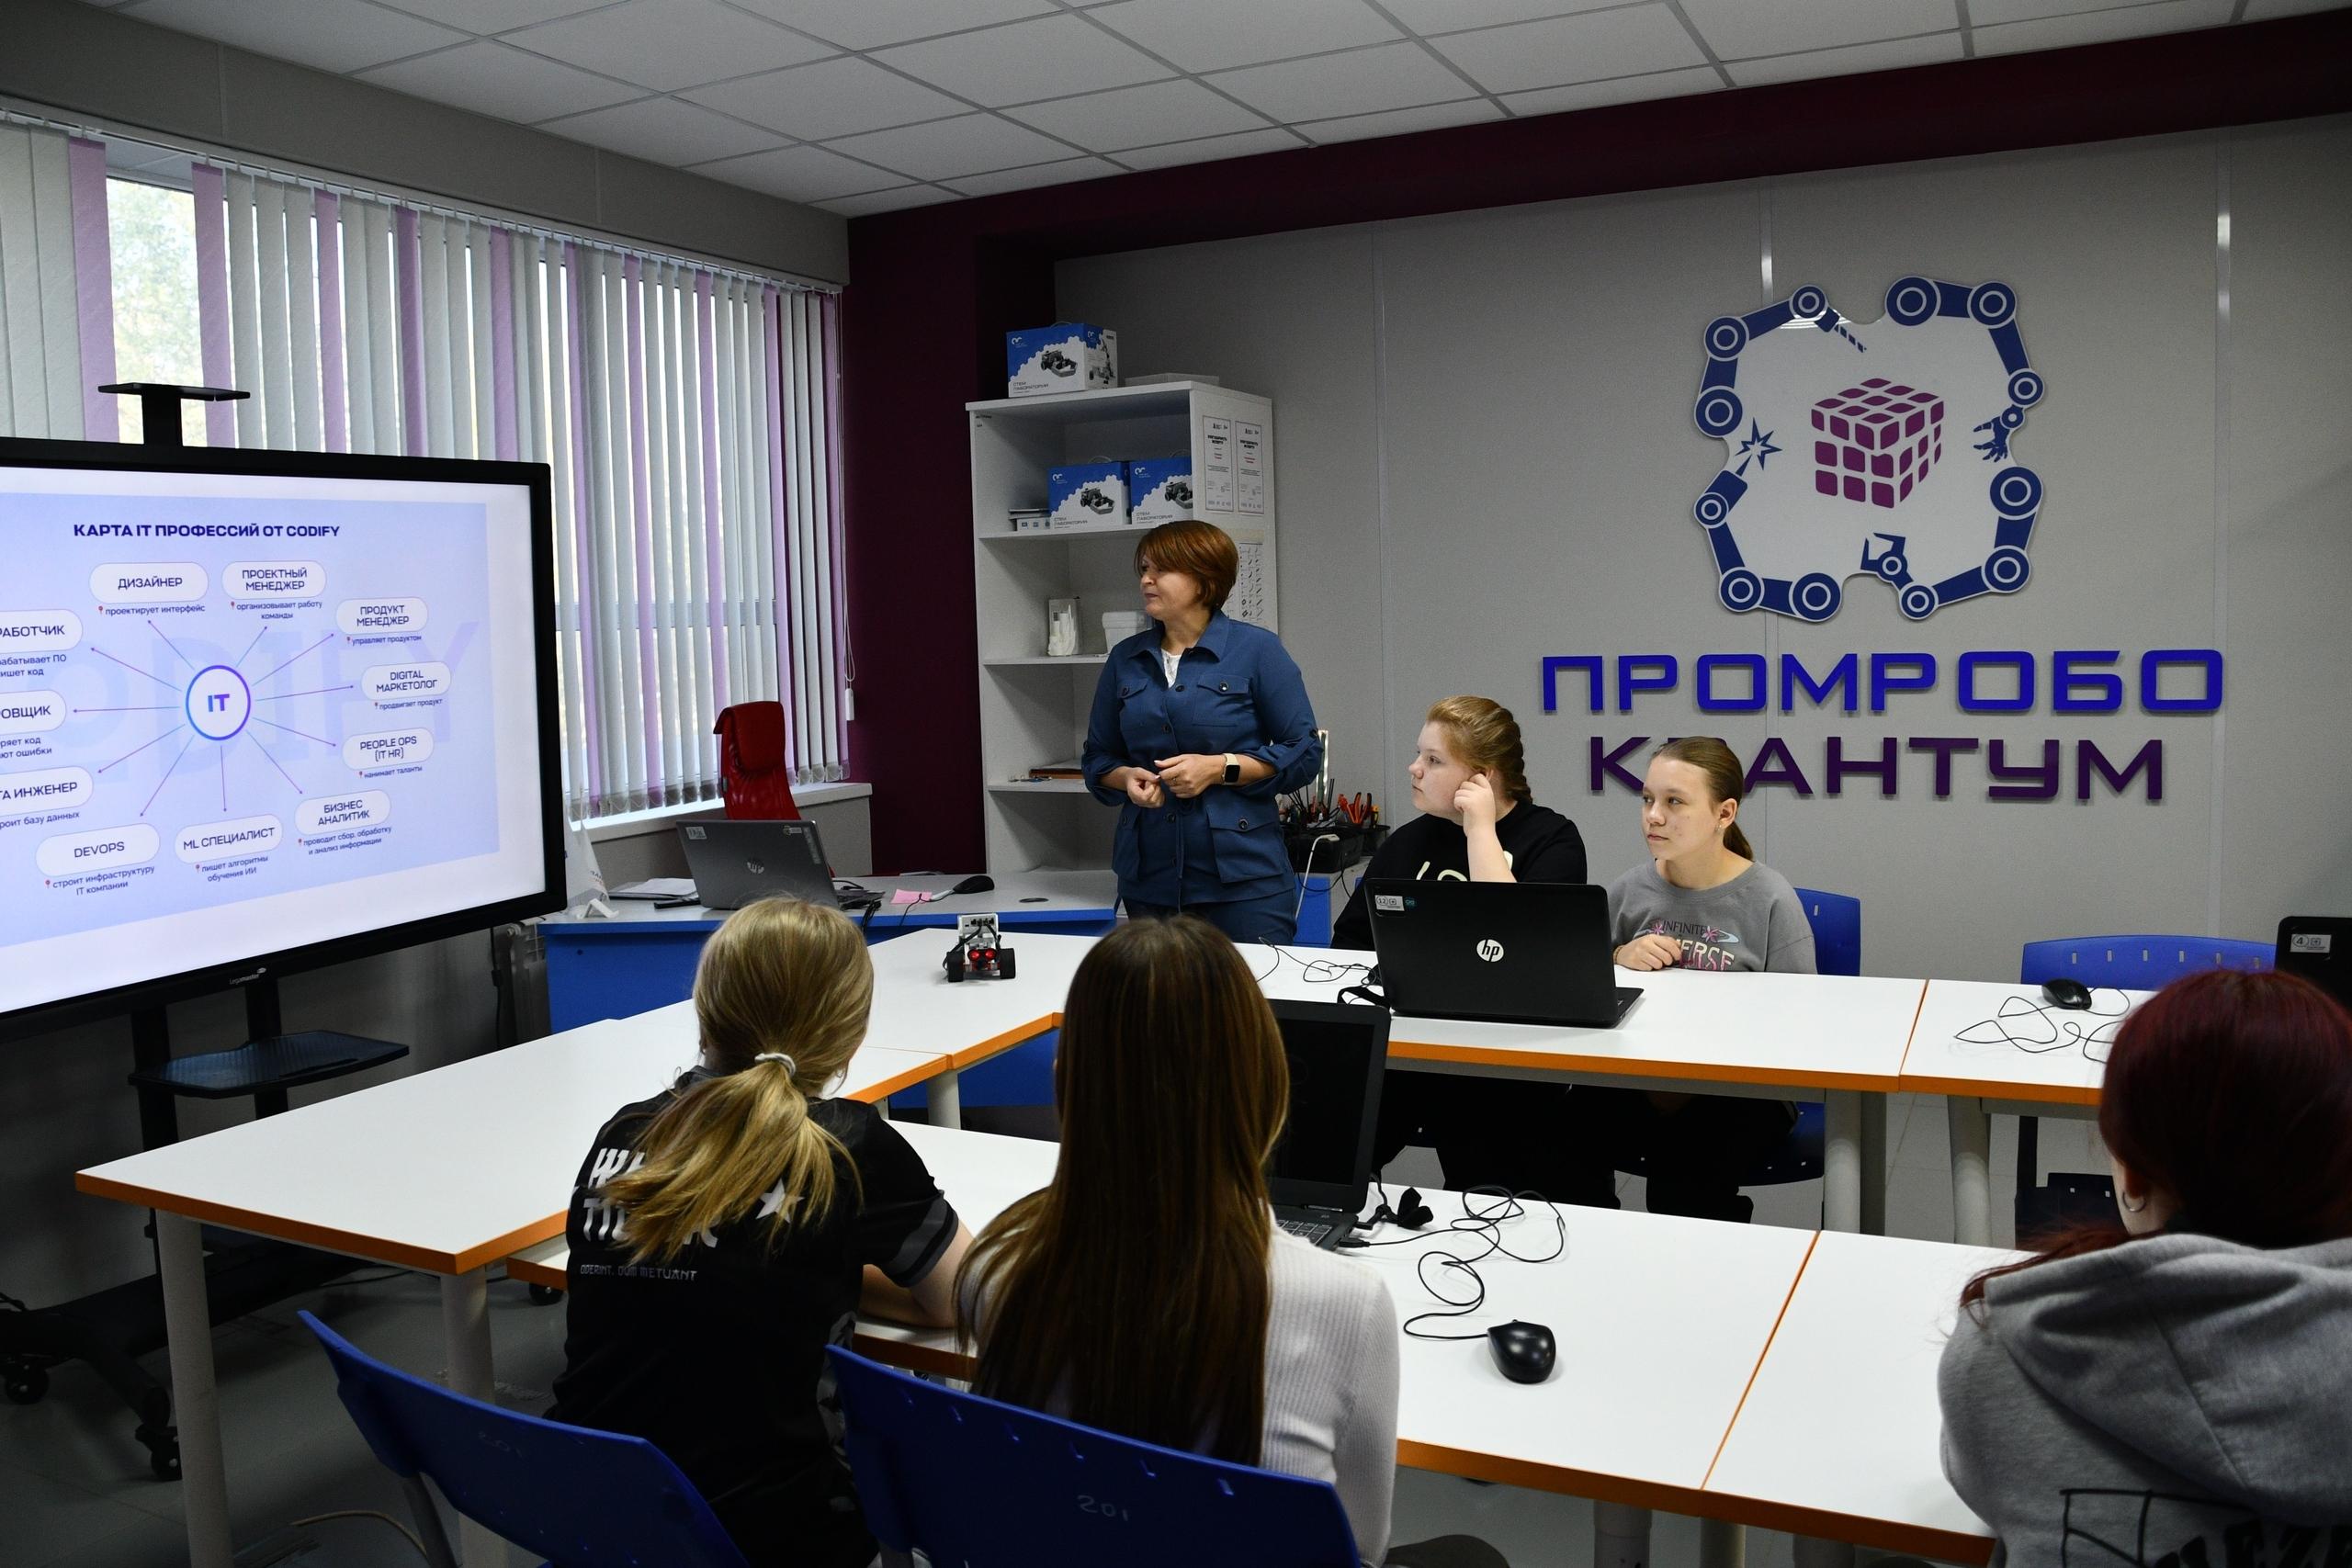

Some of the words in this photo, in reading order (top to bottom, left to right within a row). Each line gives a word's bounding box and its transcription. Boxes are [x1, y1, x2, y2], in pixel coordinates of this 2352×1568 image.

[74, 524, 133, 537] КАРТА
[137, 525, 152, 537] IT
[154, 523, 259, 537] ПРОФЕССИЙ
[263, 525, 283, 537] ОТ
[286, 525, 341, 537] CODIFY
[242, 567, 308, 580] ПРОЕКТНЫЙ
[118, 575, 183, 591] ДИЗАЙНЕР
[245, 581, 305, 592] МЕНЕДЖЕР
[105, 605, 159, 616] проектирует
[162, 604, 205, 615] интерфейс
[236, 603, 296, 611] организовывает
[298, 600, 322, 610] работу
[360, 604, 405, 616] ПРОДУКТ
[261, 613, 293, 621] команды
[356, 615, 410, 627] МЕНЕДЖЕР
[352, 637, 386, 647] управляет
[387, 635, 422, 645] продуктом
[52, 653, 67, 662] ПО
[28, 668, 44, 677] код
[390, 670, 424, 682] DIGITAL
[376, 679, 437, 694] МАРКЕТОЛОГ
[1542, 649, 2223, 713] ПРОМРОБО
[207, 693, 231, 713] IT
[379, 701, 415, 712] продвигает
[417, 698, 443, 708] продукт
[24, 737, 42, 745] код
[360, 739, 396, 750] PEOPLE
[398, 736, 418, 747] OPS
[16, 747, 52, 758] ошибки
[364, 769, 396, 779] нанимает
[397, 764, 423, 775] таланты
[1590, 736, 2163, 800] КАНТУМ
[14, 781, 78, 798] ИНЖЕНЕР
[323, 799, 364, 814] БИЗНЕС
[23, 816, 45, 826] базу
[46, 811, 81, 823] данных
[318, 809, 370, 827] АНАЛИТИК
[183, 838, 199, 851] ML
[200, 827, 277, 848] СПЕЦИАЛИСТ
[303, 835, 337, 847] проводит
[356, 825, 392, 838] обработку
[74, 840, 125, 858] DEVOPS
[314, 845, 339, 854] анализ
[339, 837, 382, 852] информации
[201, 861, 226, 873] пишет
[228, 854, 269, 870] алгоритмы
[52, 876, 84, 889] строит
[85, 864, 155, 884] инфраструктуру
[207, 869, 243, 882] обучения
[244, 866, 257, 877] ИИ
[76, 886, 85, 896] IT
[85, 880, 129, 894] компании
[1662, 919, 1706, 935] INFINITE
[1478, 939, 1502, 962] hp
[1676, 939, 1735, 970] ERSE
[1077, 1494, 1129, 1522] 201
